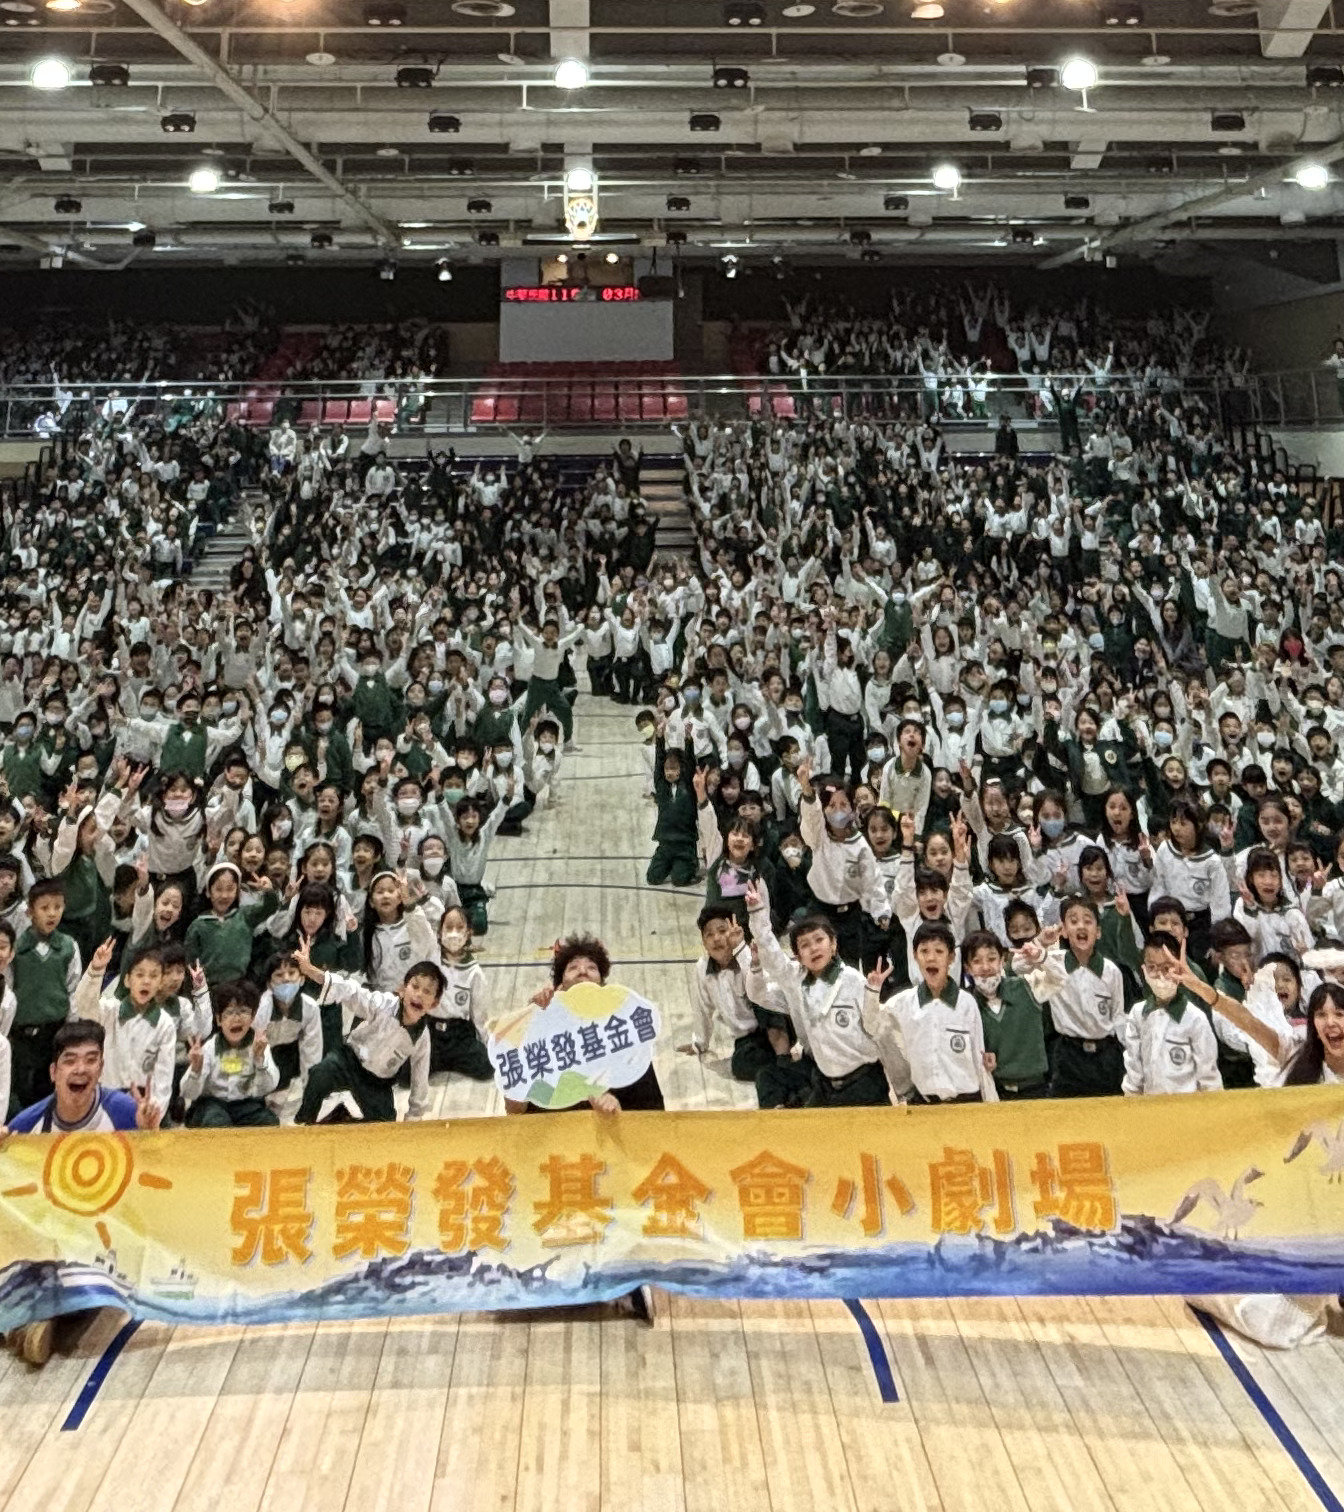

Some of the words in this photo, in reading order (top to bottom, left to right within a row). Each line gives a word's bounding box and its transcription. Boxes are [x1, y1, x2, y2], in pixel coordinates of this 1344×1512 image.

[496, 1006, 657, 1090] 張榮發基金會
[229, 1142, 1119, 1267] 張榮發基金會小劇場
